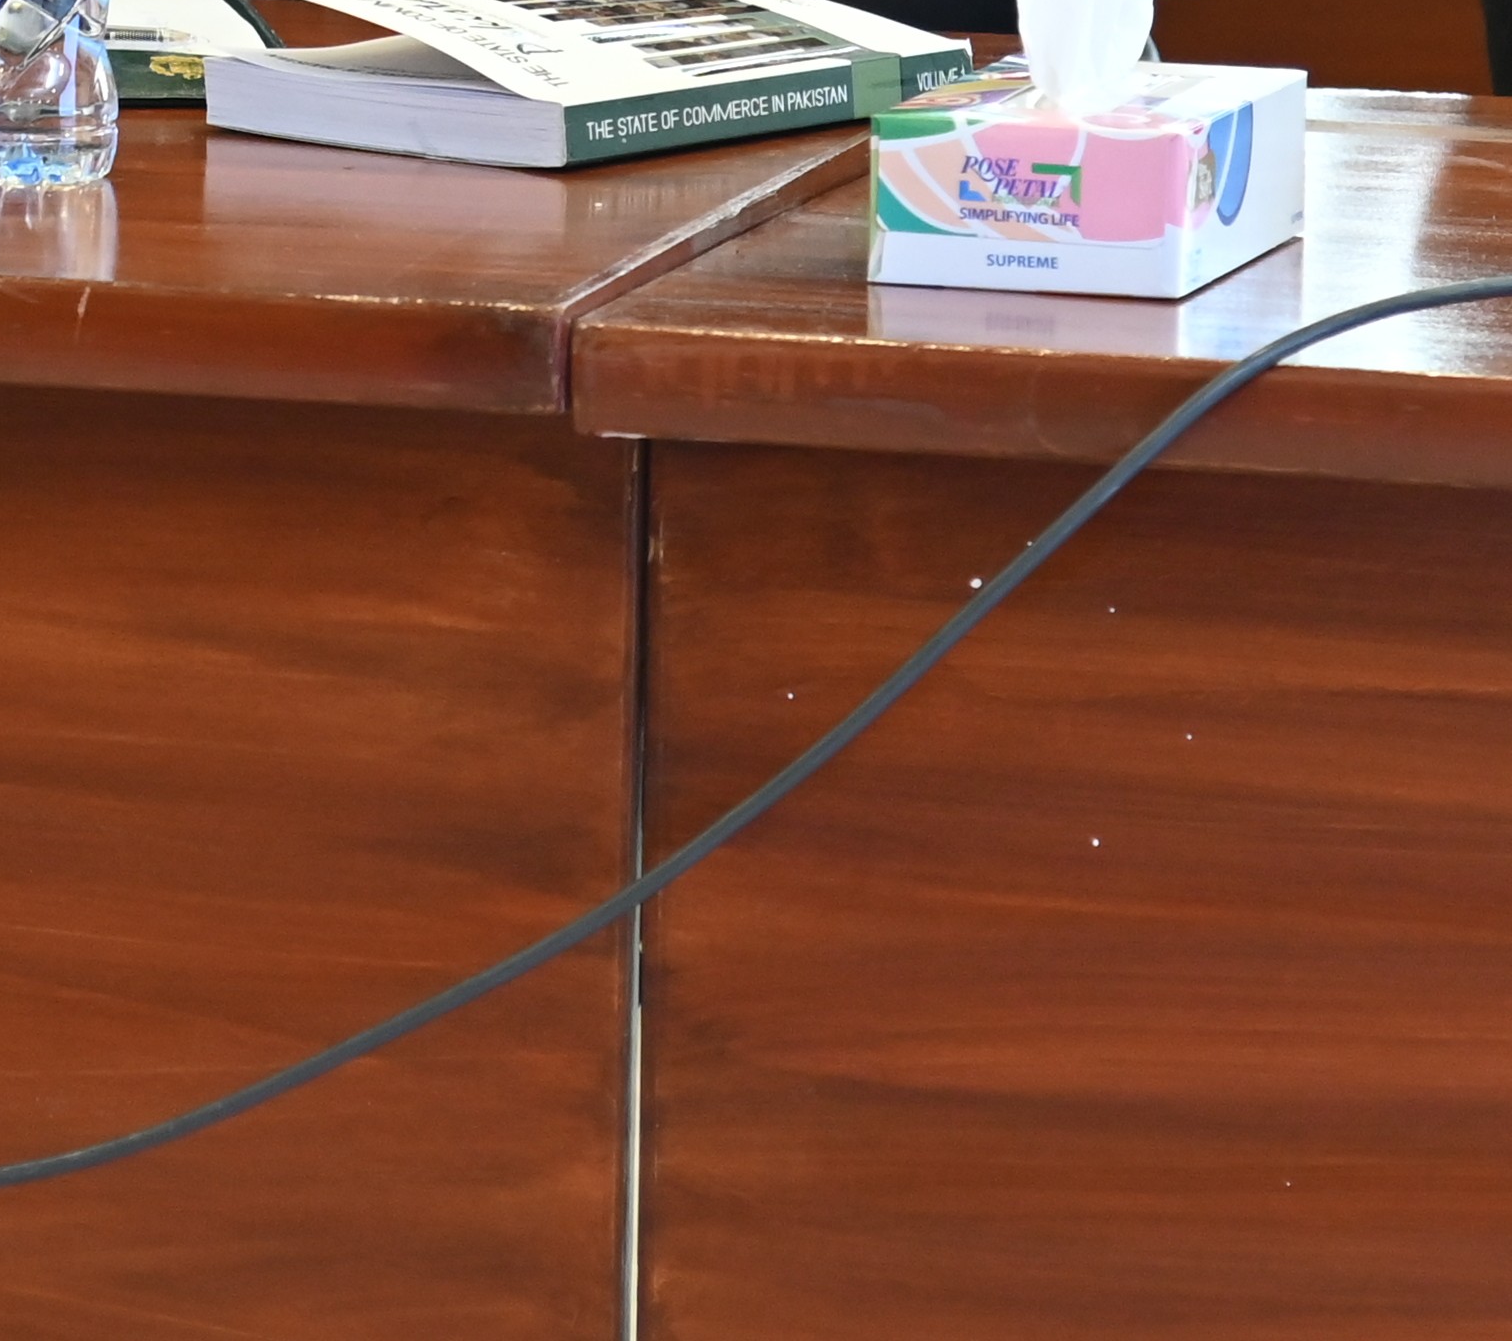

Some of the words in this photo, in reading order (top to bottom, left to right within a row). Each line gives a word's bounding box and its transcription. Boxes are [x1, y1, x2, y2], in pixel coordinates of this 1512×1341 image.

[466, 33, 529, 65] STATE
[525, 64, 570, 89] THE
[586, 118, 615, 141] THE
[617, 112, 658, 138] STATE
[661, 108, 679, 131] OF
[682, 96, 770, 126] COMMERCE
[772, 94, 786, 113] IN
[786, 84, 849, 112] PAKISTAN
[960, 155, 1020, 182] ROSE
[959, 207, 1049, 225] SIMPLIFYING
[1051, 213, 1080, 228] LIFE
[986, 253, 1058, 269] SUPREME
